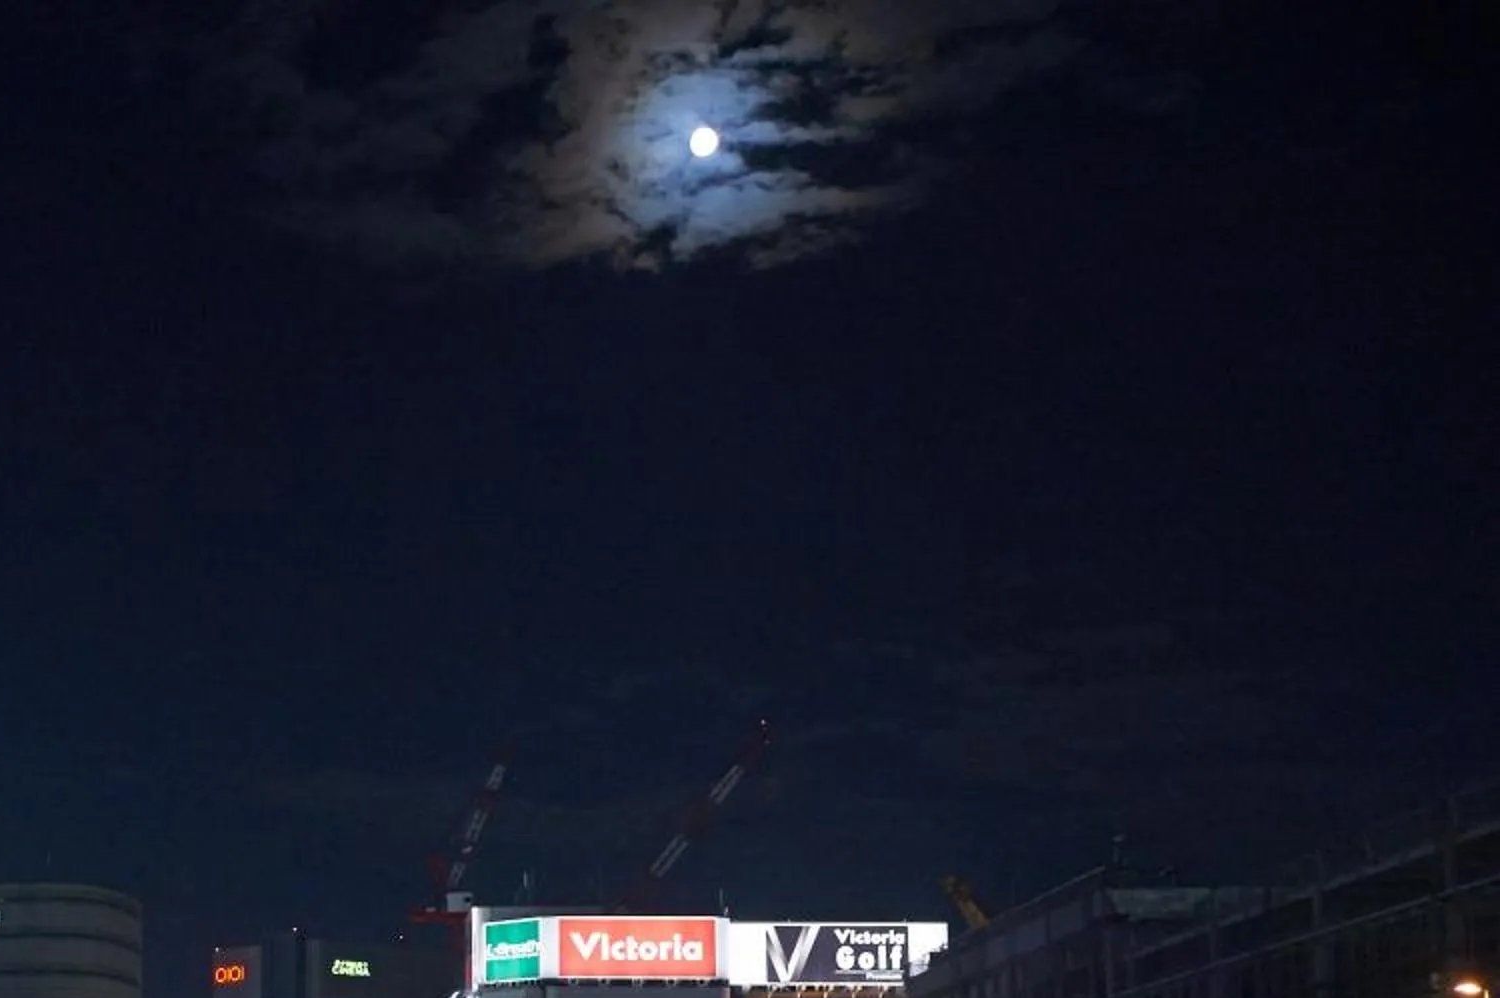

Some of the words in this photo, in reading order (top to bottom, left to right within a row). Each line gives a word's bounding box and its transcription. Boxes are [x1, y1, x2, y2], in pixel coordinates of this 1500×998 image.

[569, 930, 704, 961] Victoria
[834, 928, 905, 945] Victoria
[836, 945, 903, 970] Golf
